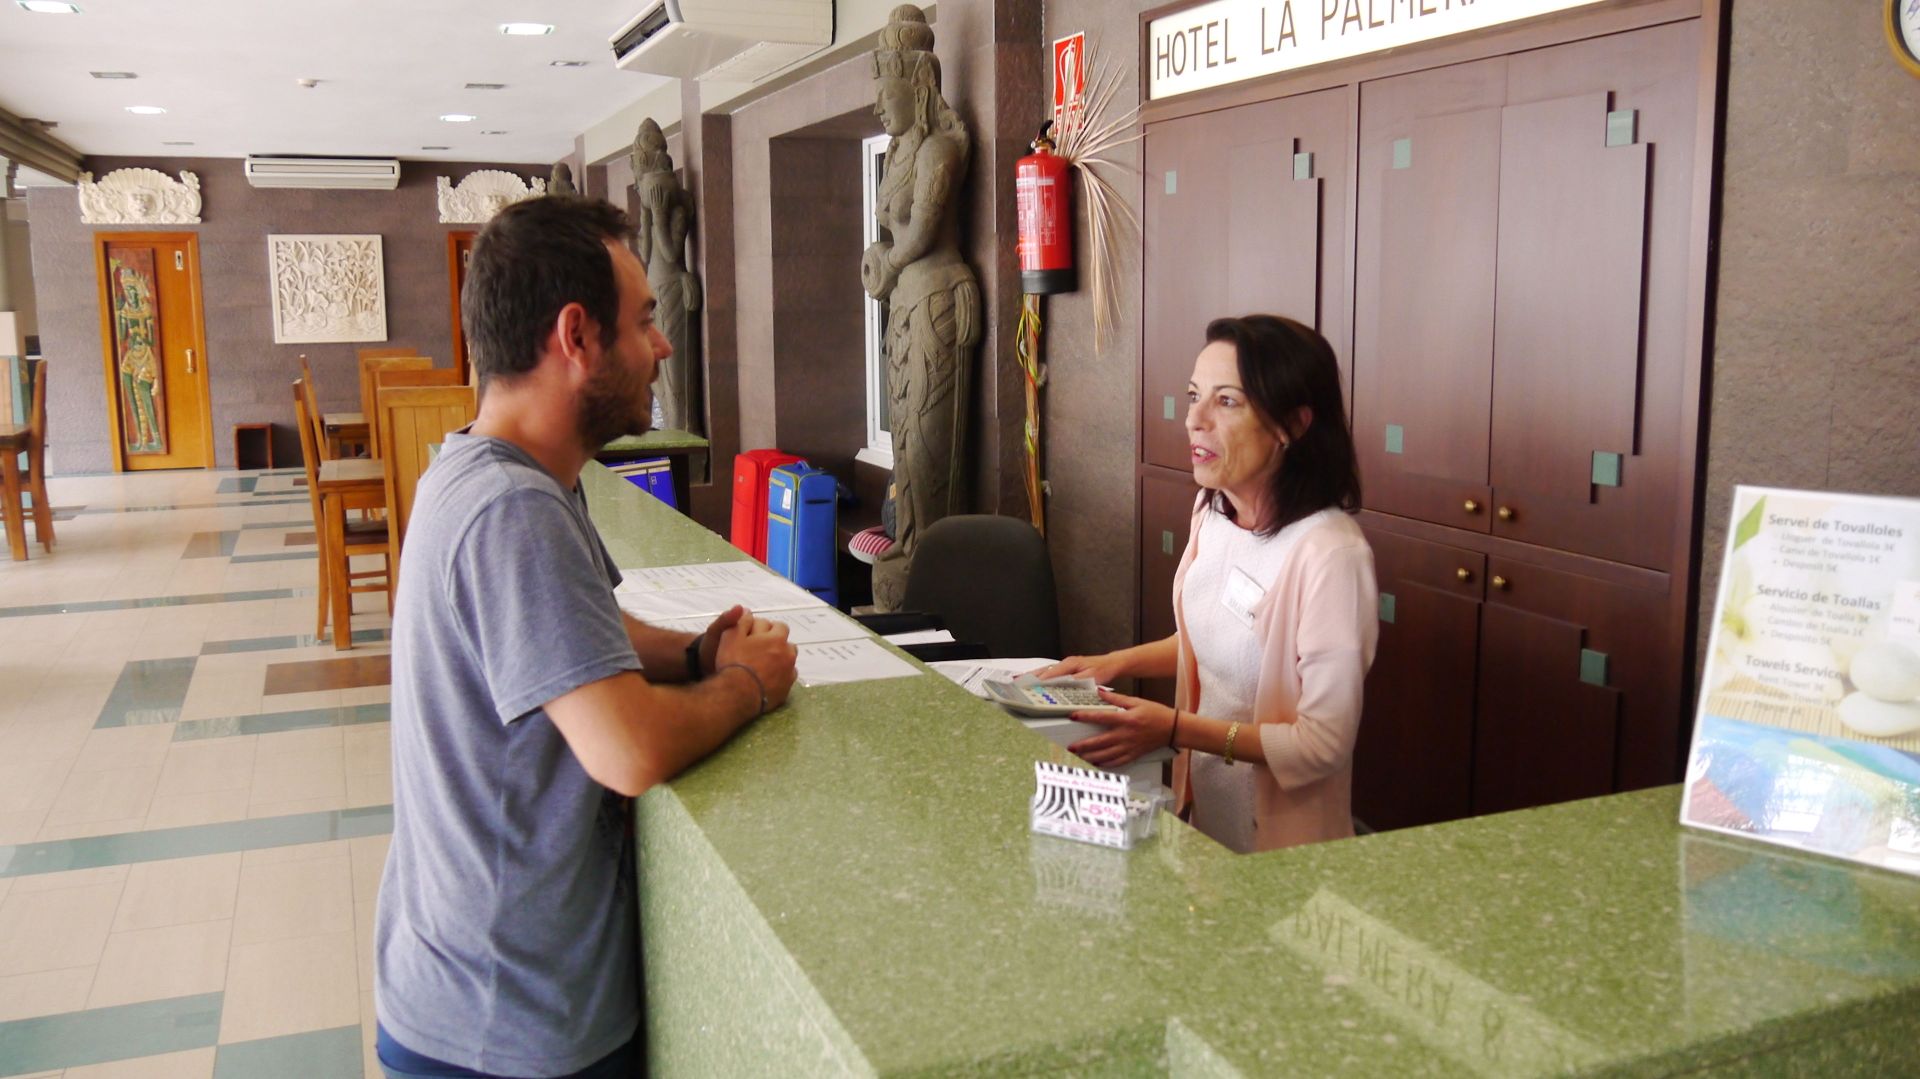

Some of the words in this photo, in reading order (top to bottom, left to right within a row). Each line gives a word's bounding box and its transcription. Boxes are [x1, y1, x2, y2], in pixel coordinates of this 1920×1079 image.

[1157, 18, 1236, 80] HOTEL
[1261, 0, 1297, 55] LA
[1768, 513, 1809, 528] Servei
[1813, 518, 1829, 530] de
[1834, 520, 1903, 538] Tovalloles
[1758, 584, 1808, 600] Servicio
[1812, 592, 1828, 603] de
[1833, 594, 1880, 610] Toallas
[1745, 655, 1791, 672] Towels
[1794, 662, 1841, 680] Service
